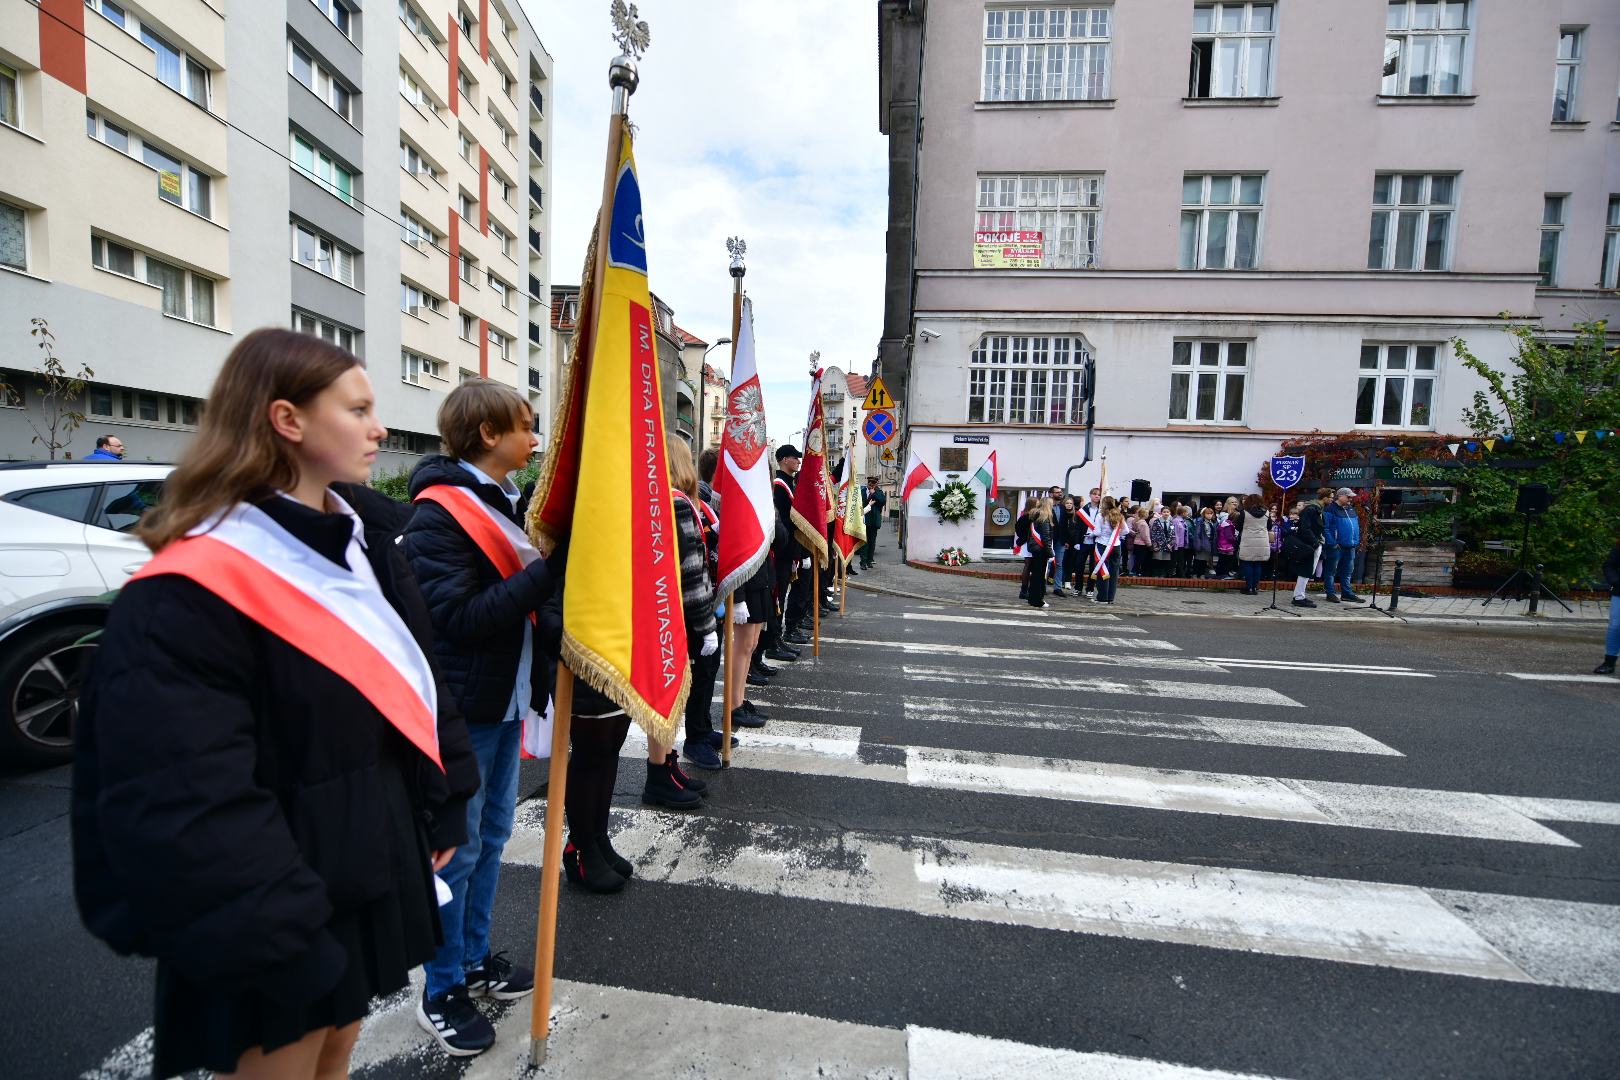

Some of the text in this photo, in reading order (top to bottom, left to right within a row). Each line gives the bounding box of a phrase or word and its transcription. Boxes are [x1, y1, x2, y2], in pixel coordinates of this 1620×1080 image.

[976, 232, 1021, 243] POKOJE
[1275, 469, 1298, 482] 23
[639, 323, 677, 688] IM. DRA FRANCISZKA WITASZKA
